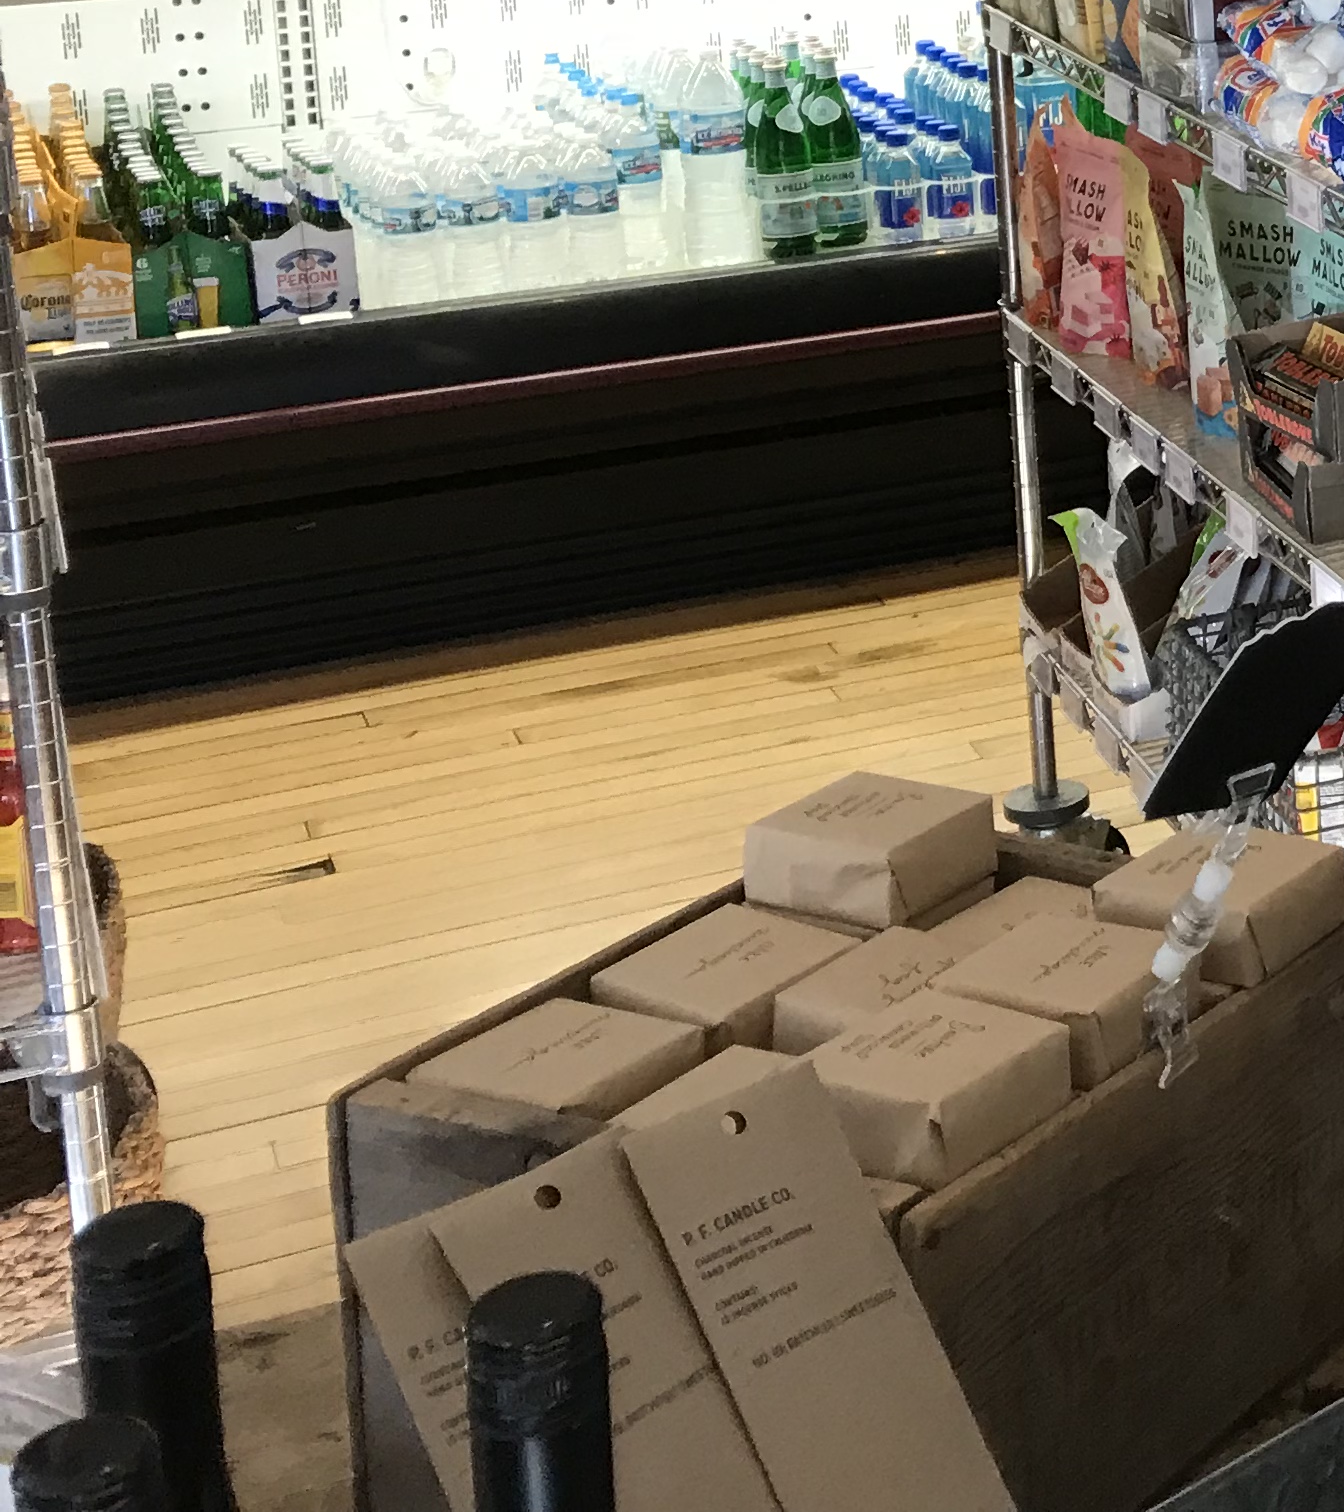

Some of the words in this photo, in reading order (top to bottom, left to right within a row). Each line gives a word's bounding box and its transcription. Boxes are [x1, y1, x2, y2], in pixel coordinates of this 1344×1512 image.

[893, 177, 918, 198] FIJI
[942, 175, 967, 196] FIJI
[1227, 220, 1295, 244] SMASH
[1219, 239, 1301, 268] MALLOW
[275, 268, 340, 289] PERONI
[20, 293, 71, 311] Corona
[713, 1195, 770, 1233] CANDLE
[771, 1187, 797, 1206] CO.
